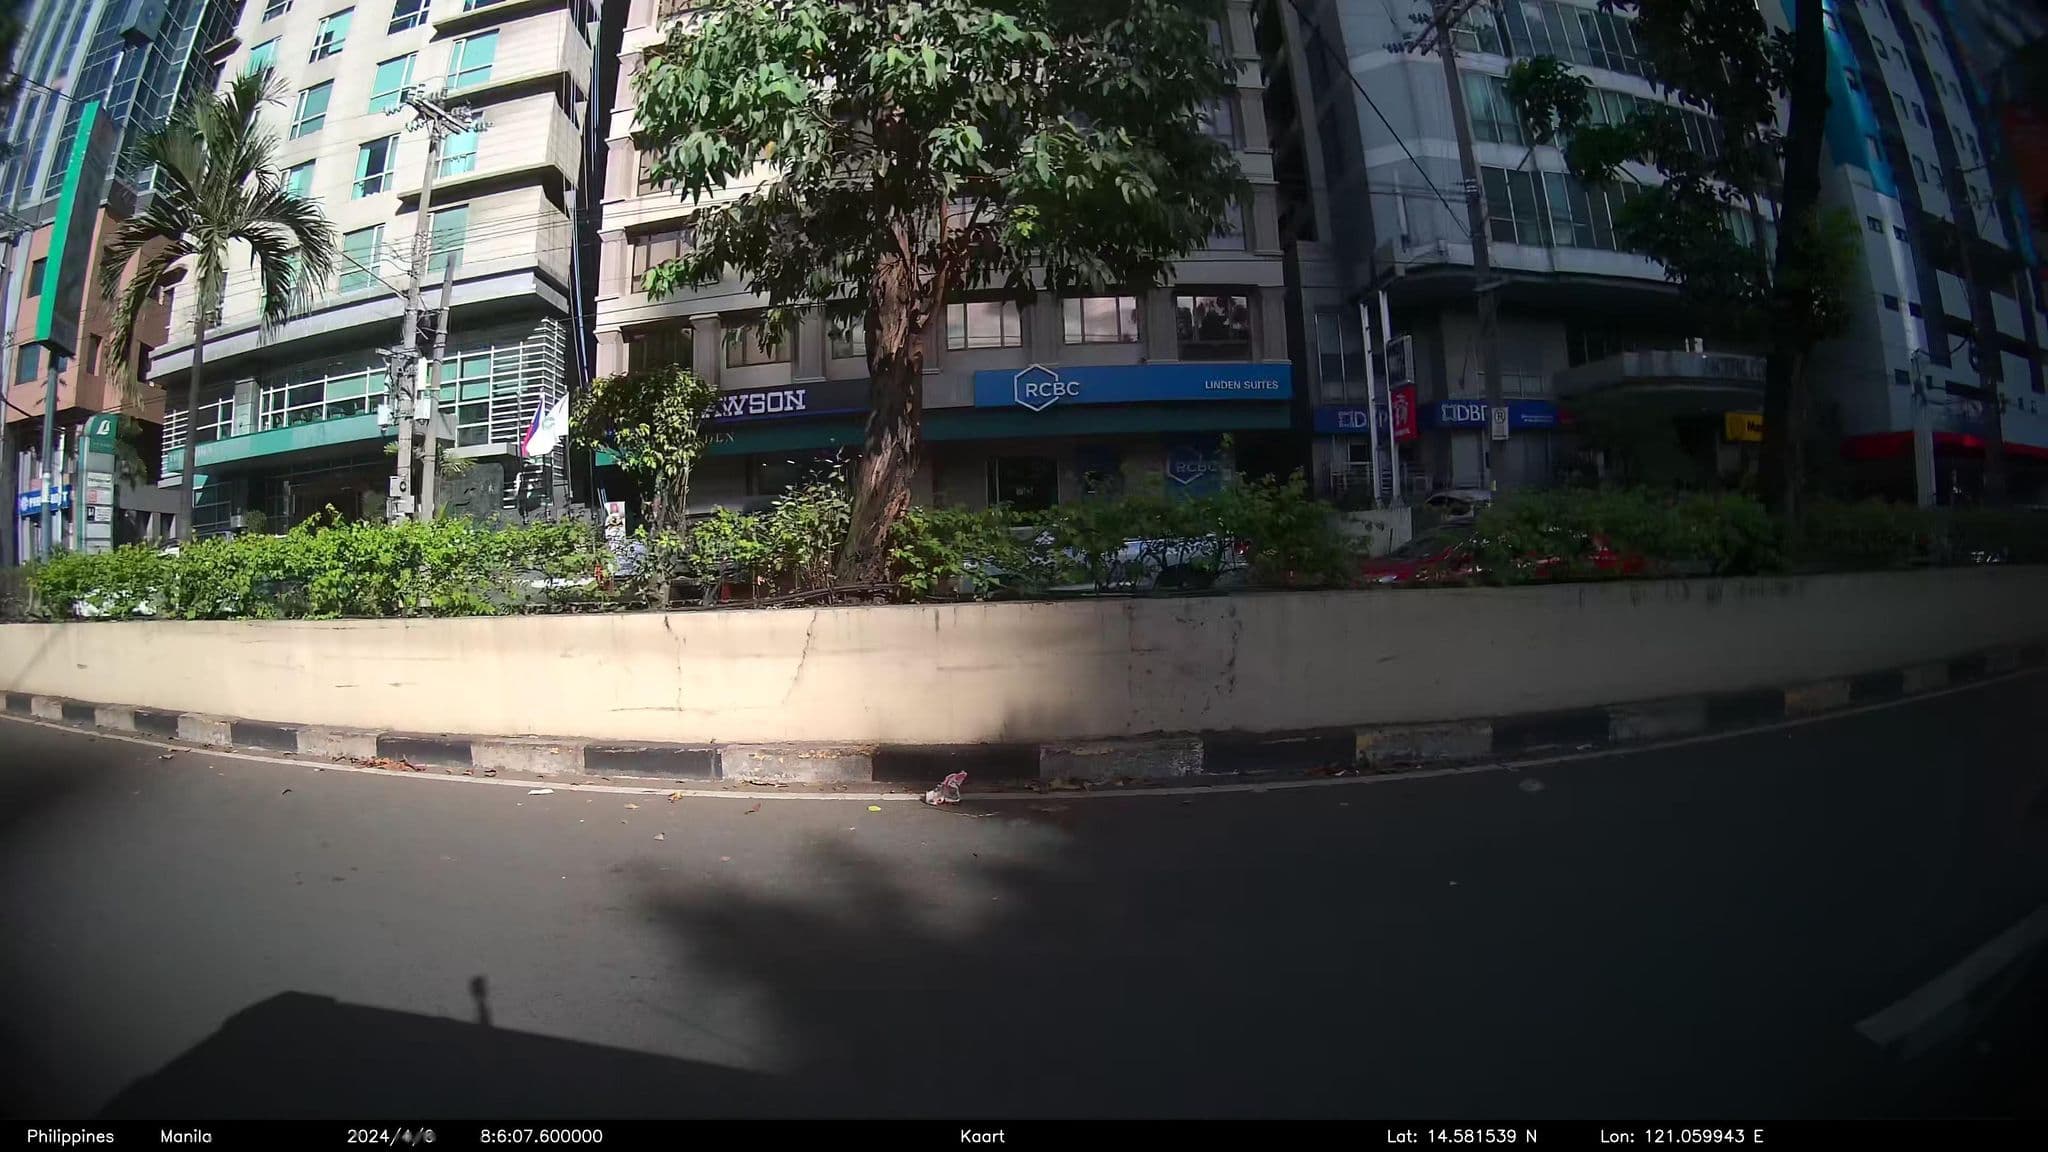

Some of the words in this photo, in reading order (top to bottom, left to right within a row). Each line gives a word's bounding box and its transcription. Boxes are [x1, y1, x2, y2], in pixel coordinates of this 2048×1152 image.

[1025, 381, 1081, 398] RCBC
[1205, 380, 1241, 390] LINDEN
[1244, 380, 1280, 390] SUITES
